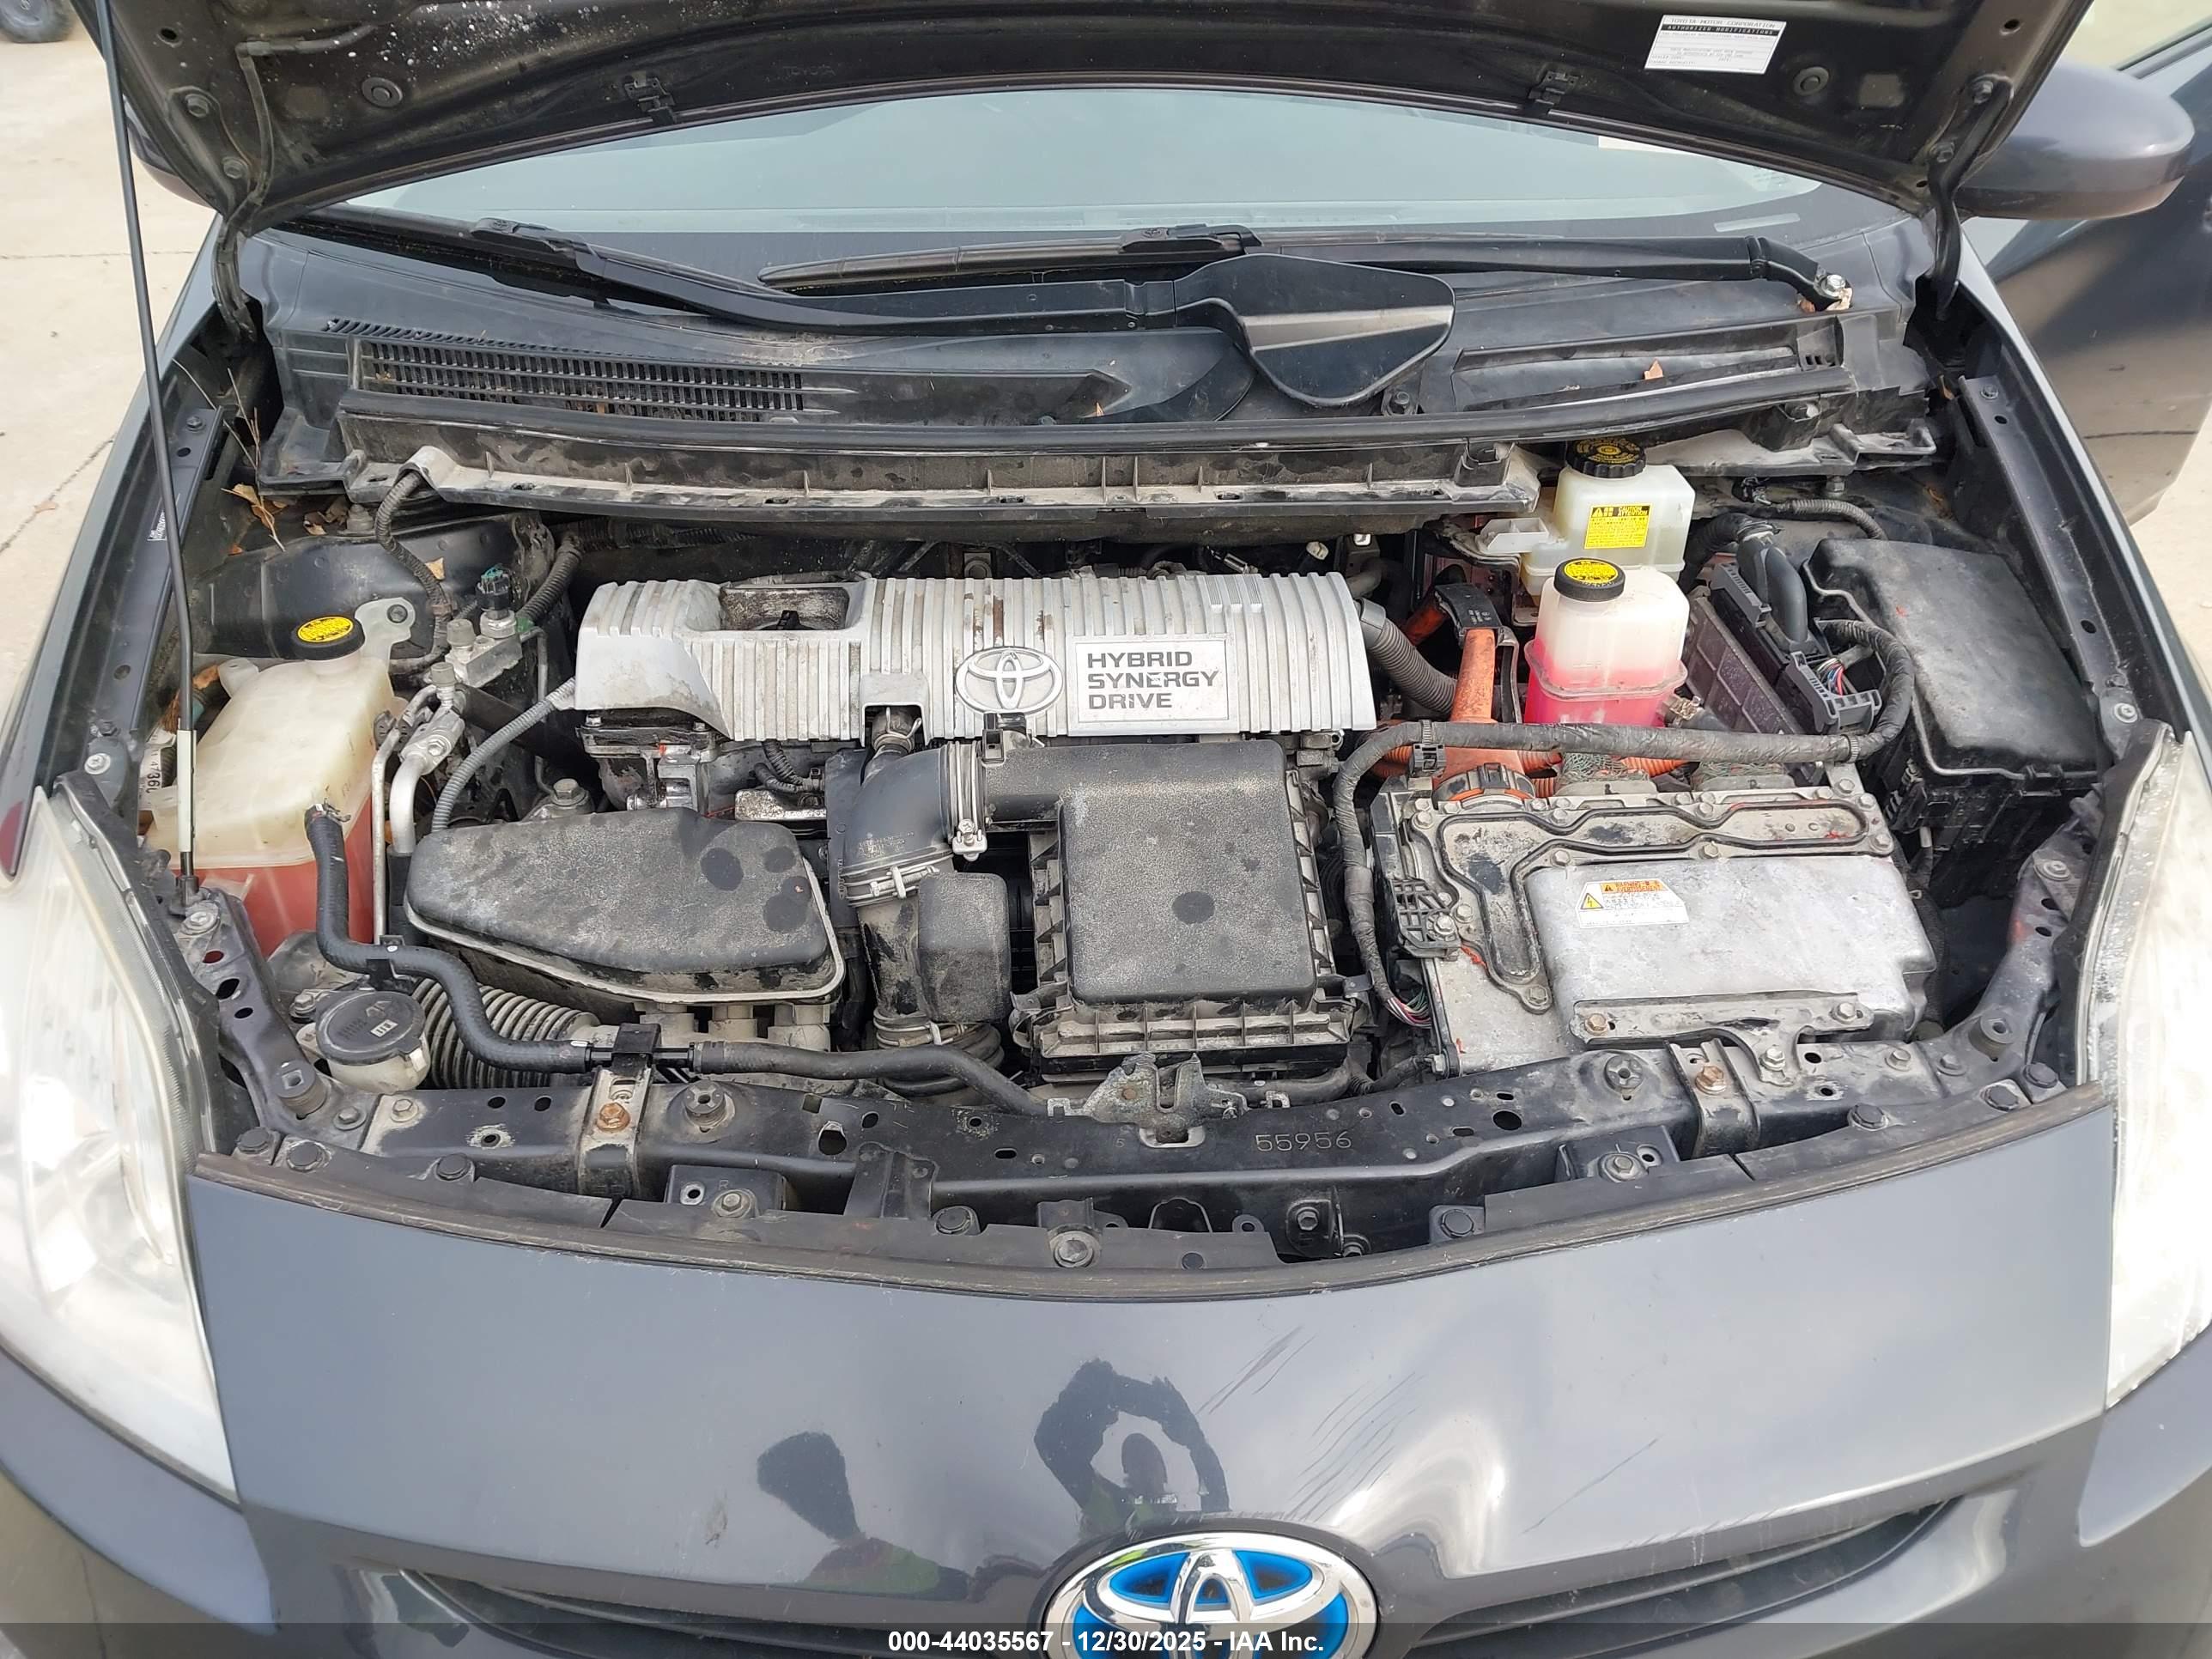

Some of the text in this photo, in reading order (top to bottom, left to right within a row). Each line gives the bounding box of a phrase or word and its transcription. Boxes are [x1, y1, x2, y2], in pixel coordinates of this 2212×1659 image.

[1087, 651, 1193, 668] HYBRID
[1087, 670, 1218, 690] SYNERGY
[1088, 692, 1172, 709] DRIVE
[1255, 1130, 1352, 1152] 55956
